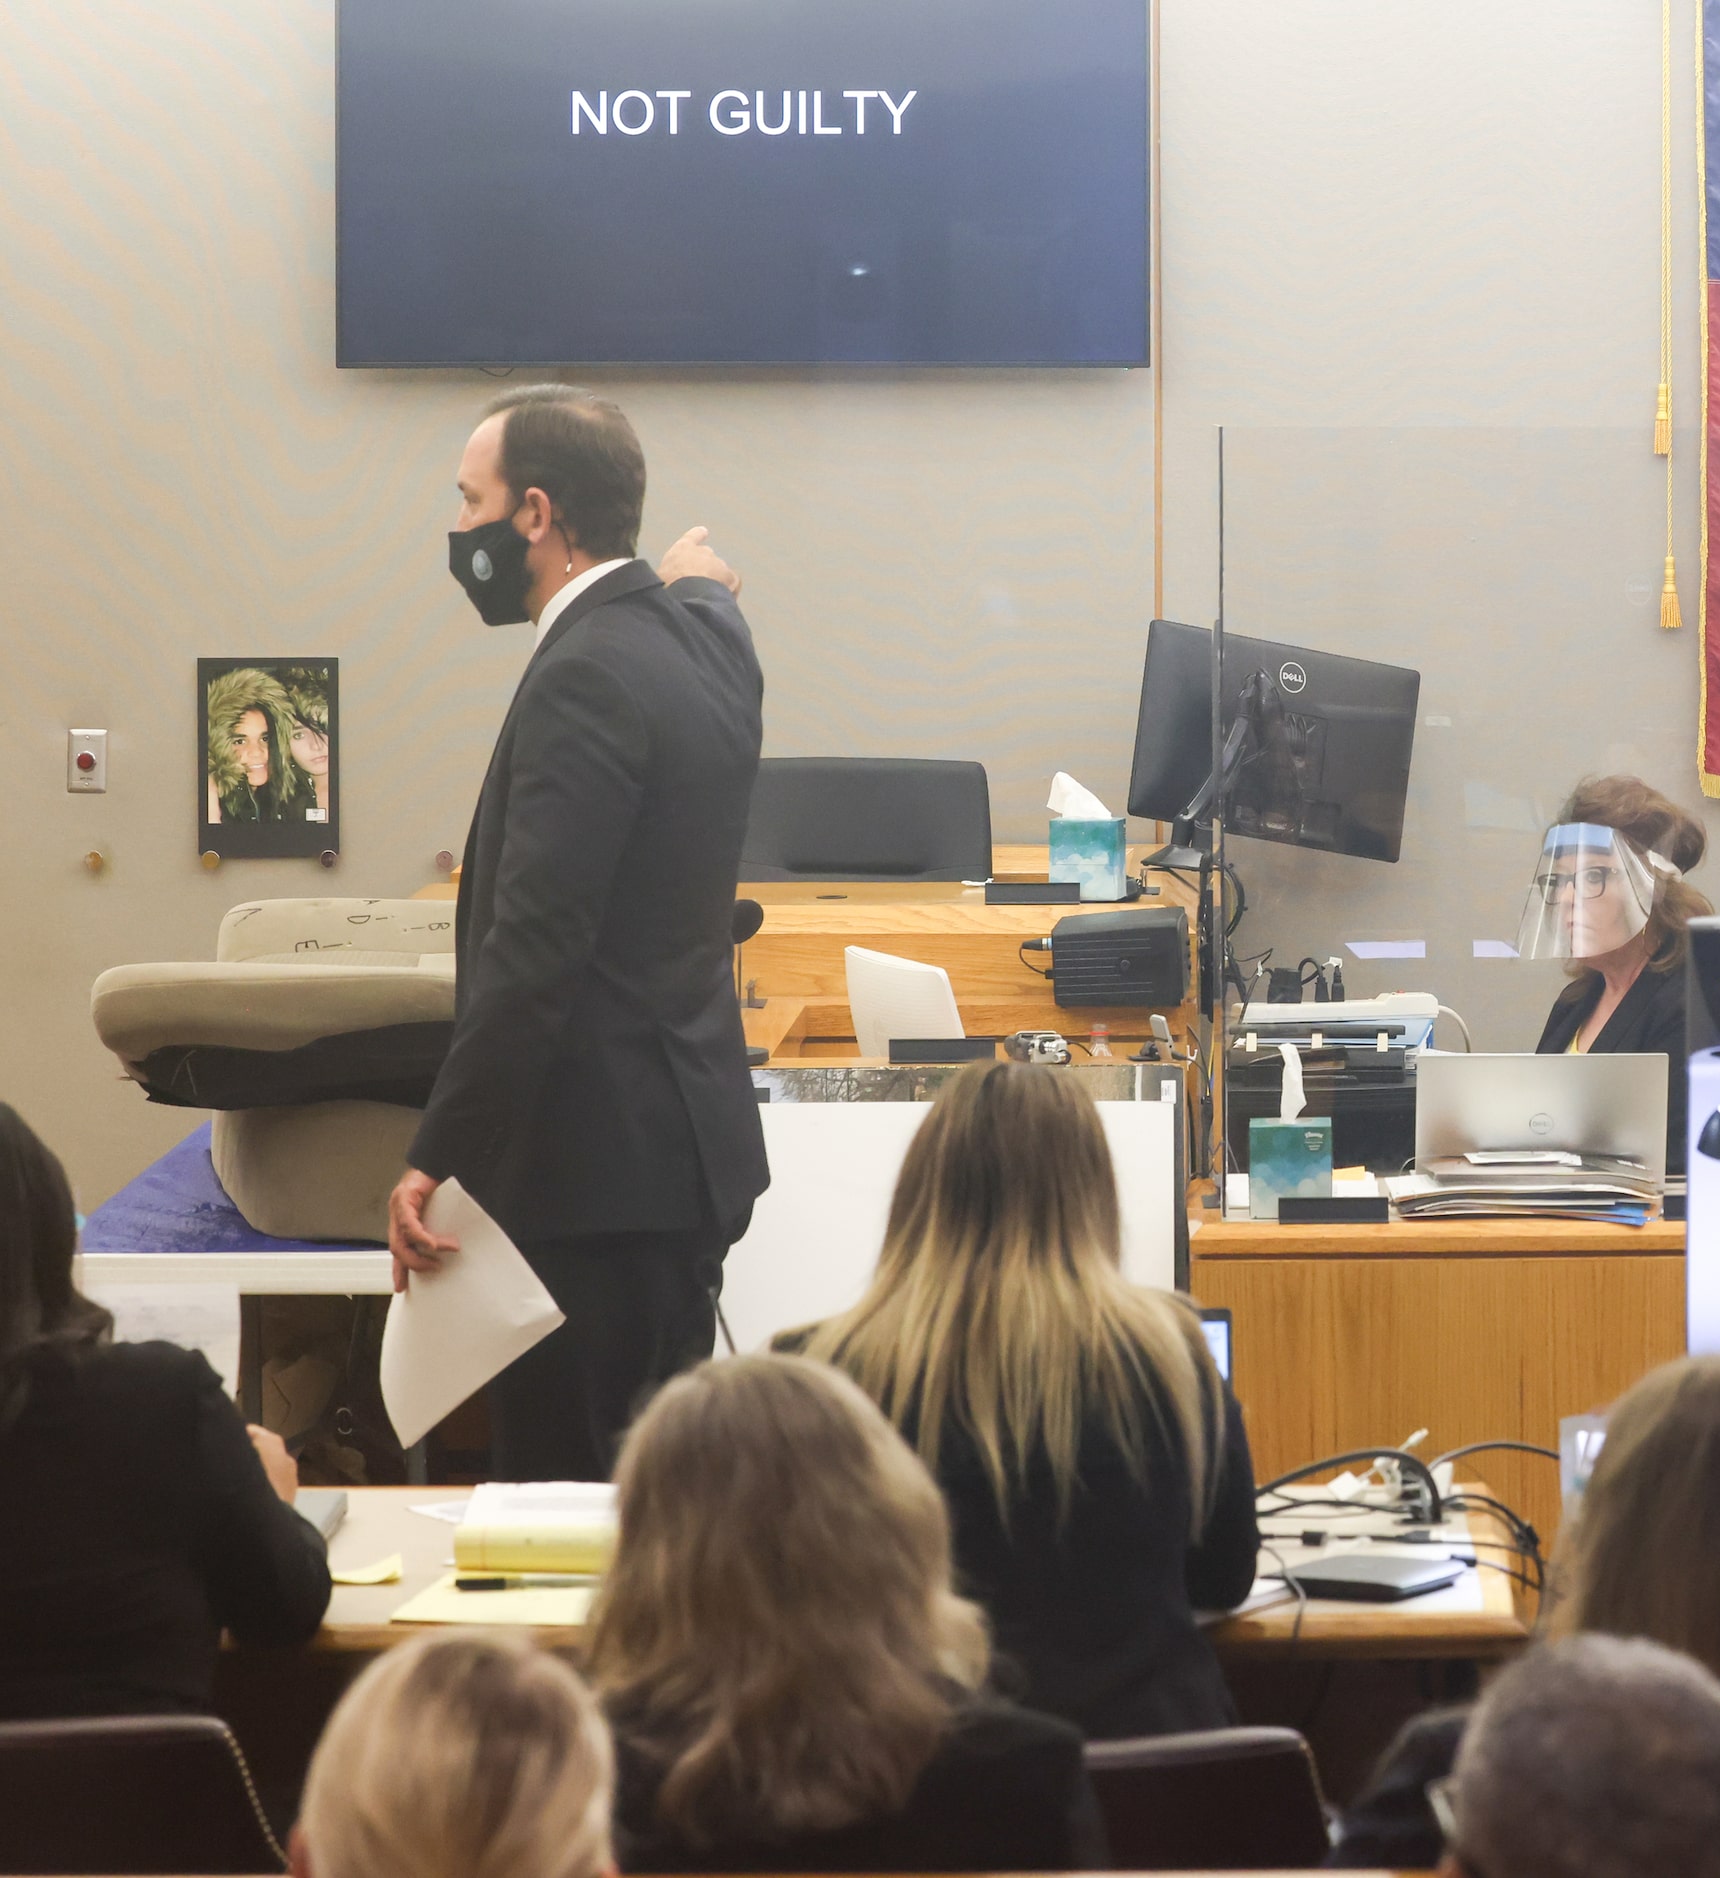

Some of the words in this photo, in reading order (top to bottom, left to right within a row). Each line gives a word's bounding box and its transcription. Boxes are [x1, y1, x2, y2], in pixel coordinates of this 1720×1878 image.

[571, 89, 692, 136] NOT
[709, 89, 918, 136] GUILTY
[1283, 672, 1304, 683] DELL
